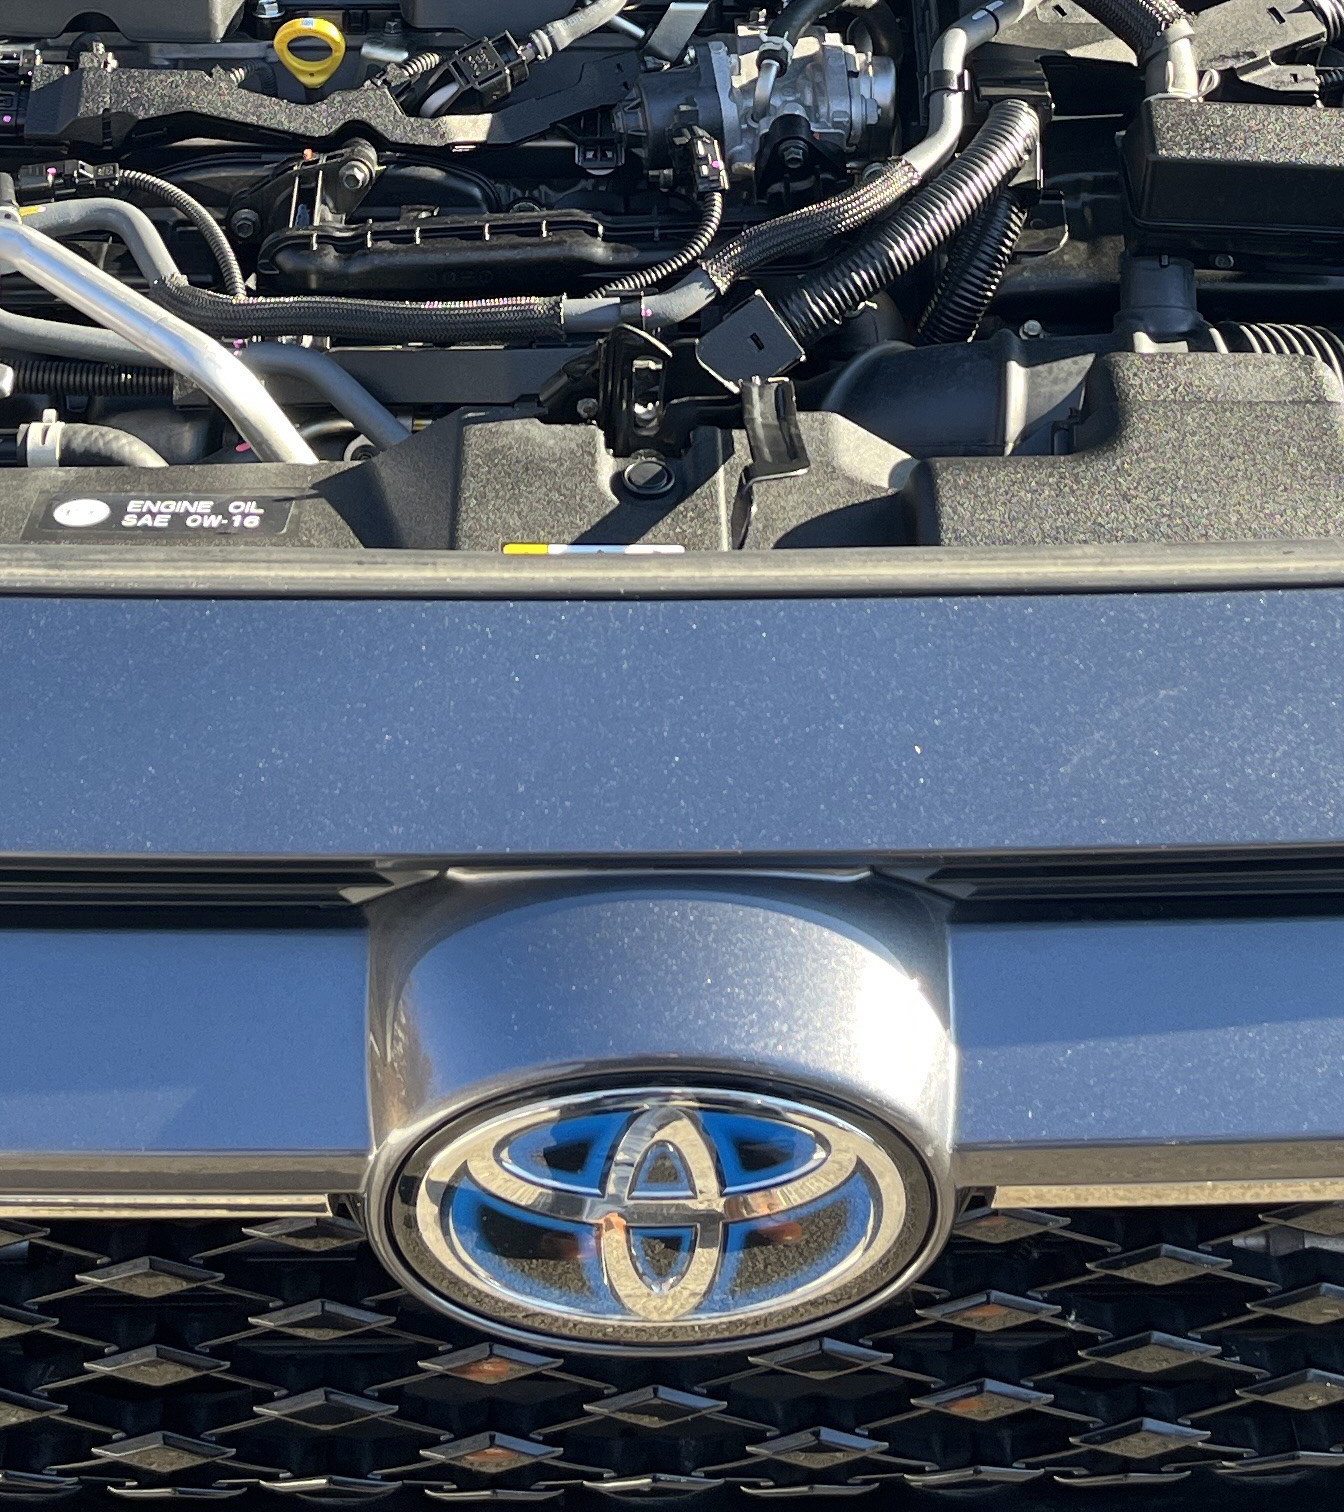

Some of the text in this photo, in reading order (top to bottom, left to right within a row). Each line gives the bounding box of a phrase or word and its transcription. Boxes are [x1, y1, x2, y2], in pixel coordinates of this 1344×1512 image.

[126, 500, 265, 514] ENGINE OIL
[121, 514, 171, 528] SAE
